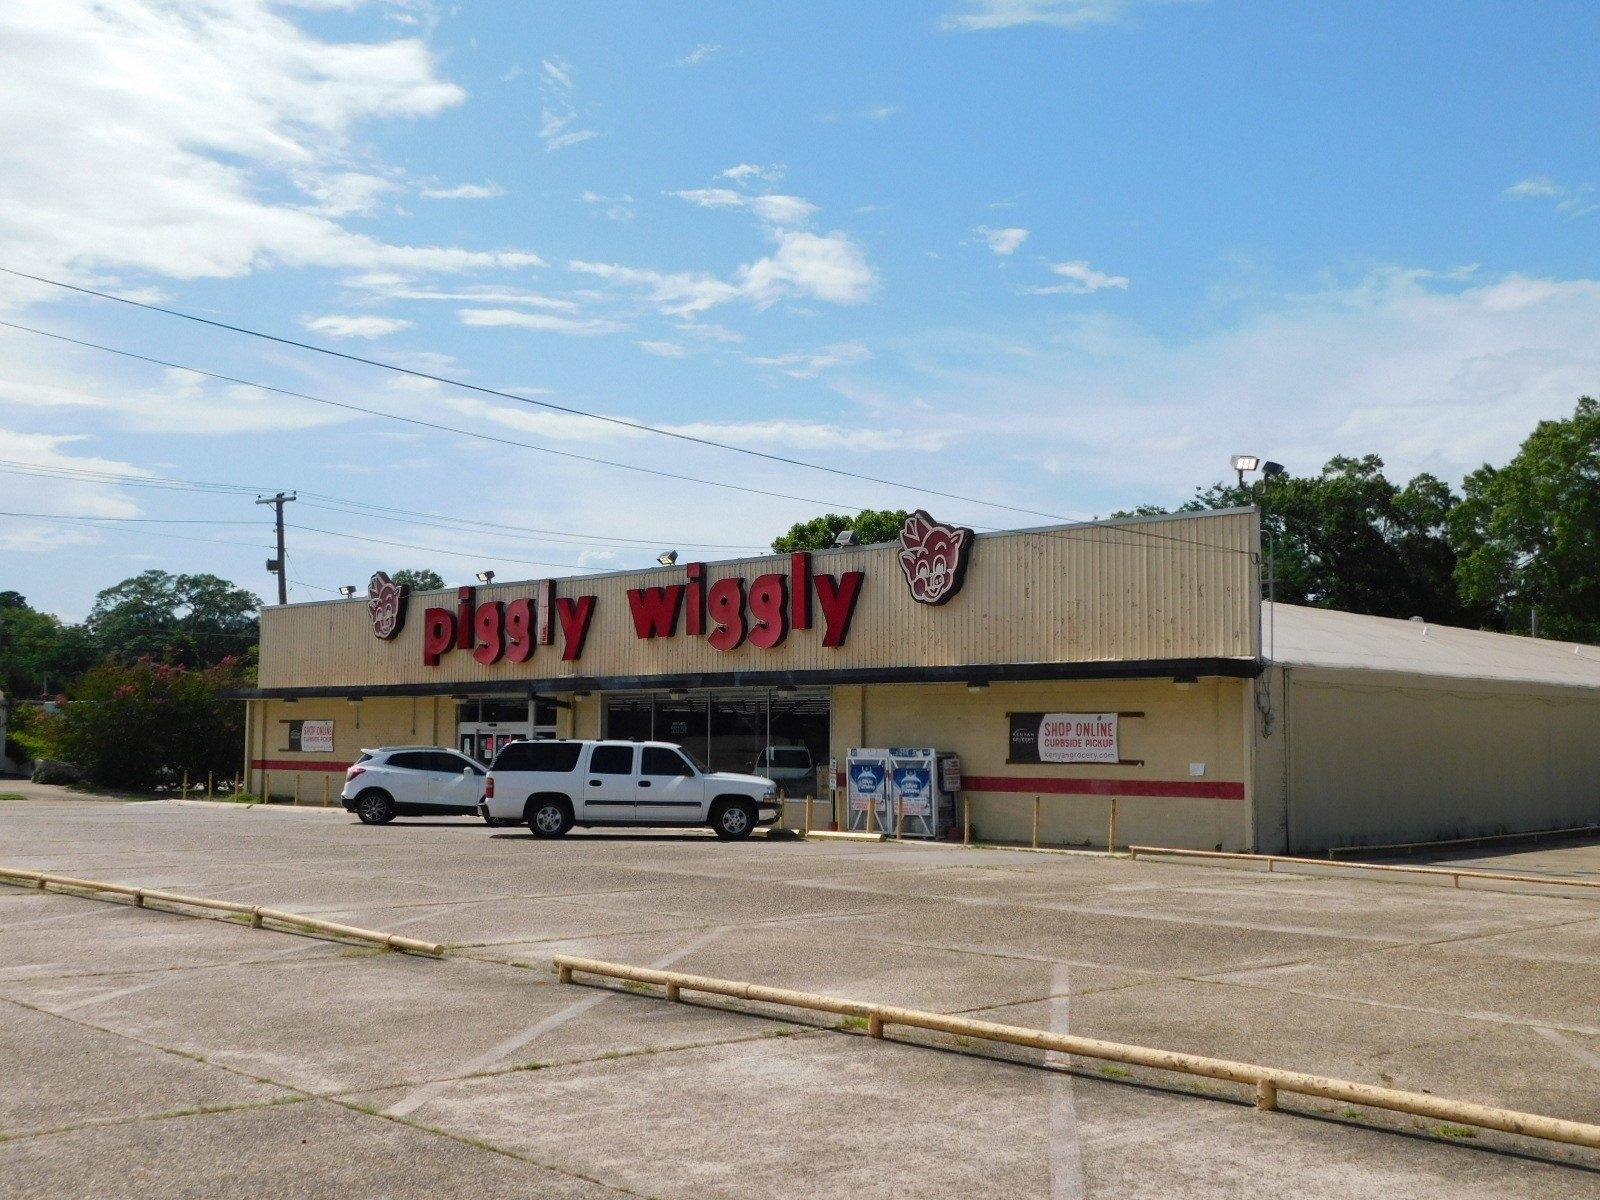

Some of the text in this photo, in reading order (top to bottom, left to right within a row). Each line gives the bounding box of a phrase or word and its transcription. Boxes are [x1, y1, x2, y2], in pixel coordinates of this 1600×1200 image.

[425, 552, 864, 666] piggly wiggly
[1044, 722, 1114, 737] SHOP ONLINE
[1044, 739, 1114, 748] CURBSIDE PICKUP
